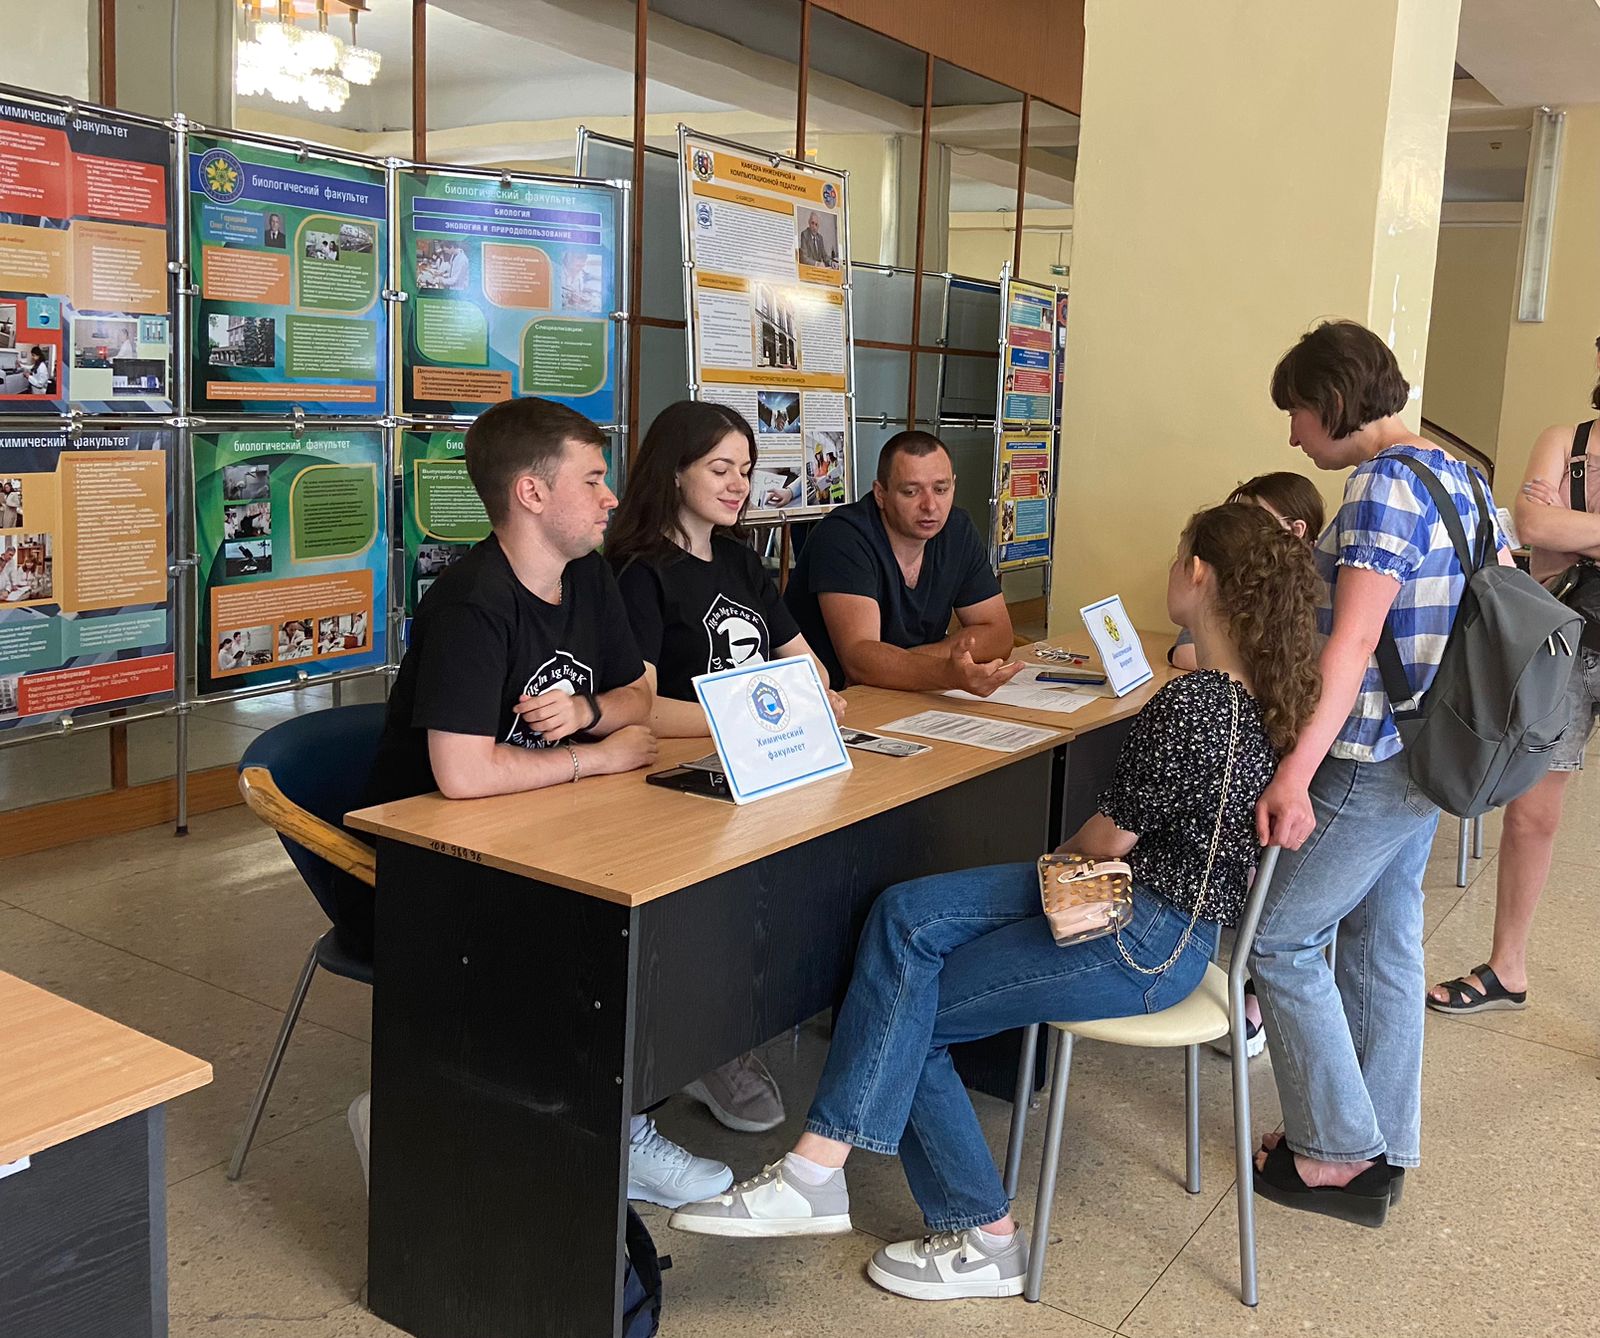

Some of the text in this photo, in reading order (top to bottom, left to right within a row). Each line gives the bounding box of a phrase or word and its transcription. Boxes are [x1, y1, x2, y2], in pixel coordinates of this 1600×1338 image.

[0, 104, 129, 138] химический факультет
[252, 174, 369, 205] биологический факультет
[444, 183, 576, 206] биологический факультет
[494, 208, 531, 218] БИОЛОГИЯ
[444, 221, 572, 240] ЭКОЛОГИЯ И ПРИРОДОПОЛЬЗОВАНИЕ
[0, 434, 130, 450] химический факультет
[234, 438, 350, 452] биологический факультет
[740, 610, 750, 620] Ag
[576, 673, 588, 686] K
[756, 726, 804, 748] Химический
[768, 743, 806, 760] факультет
